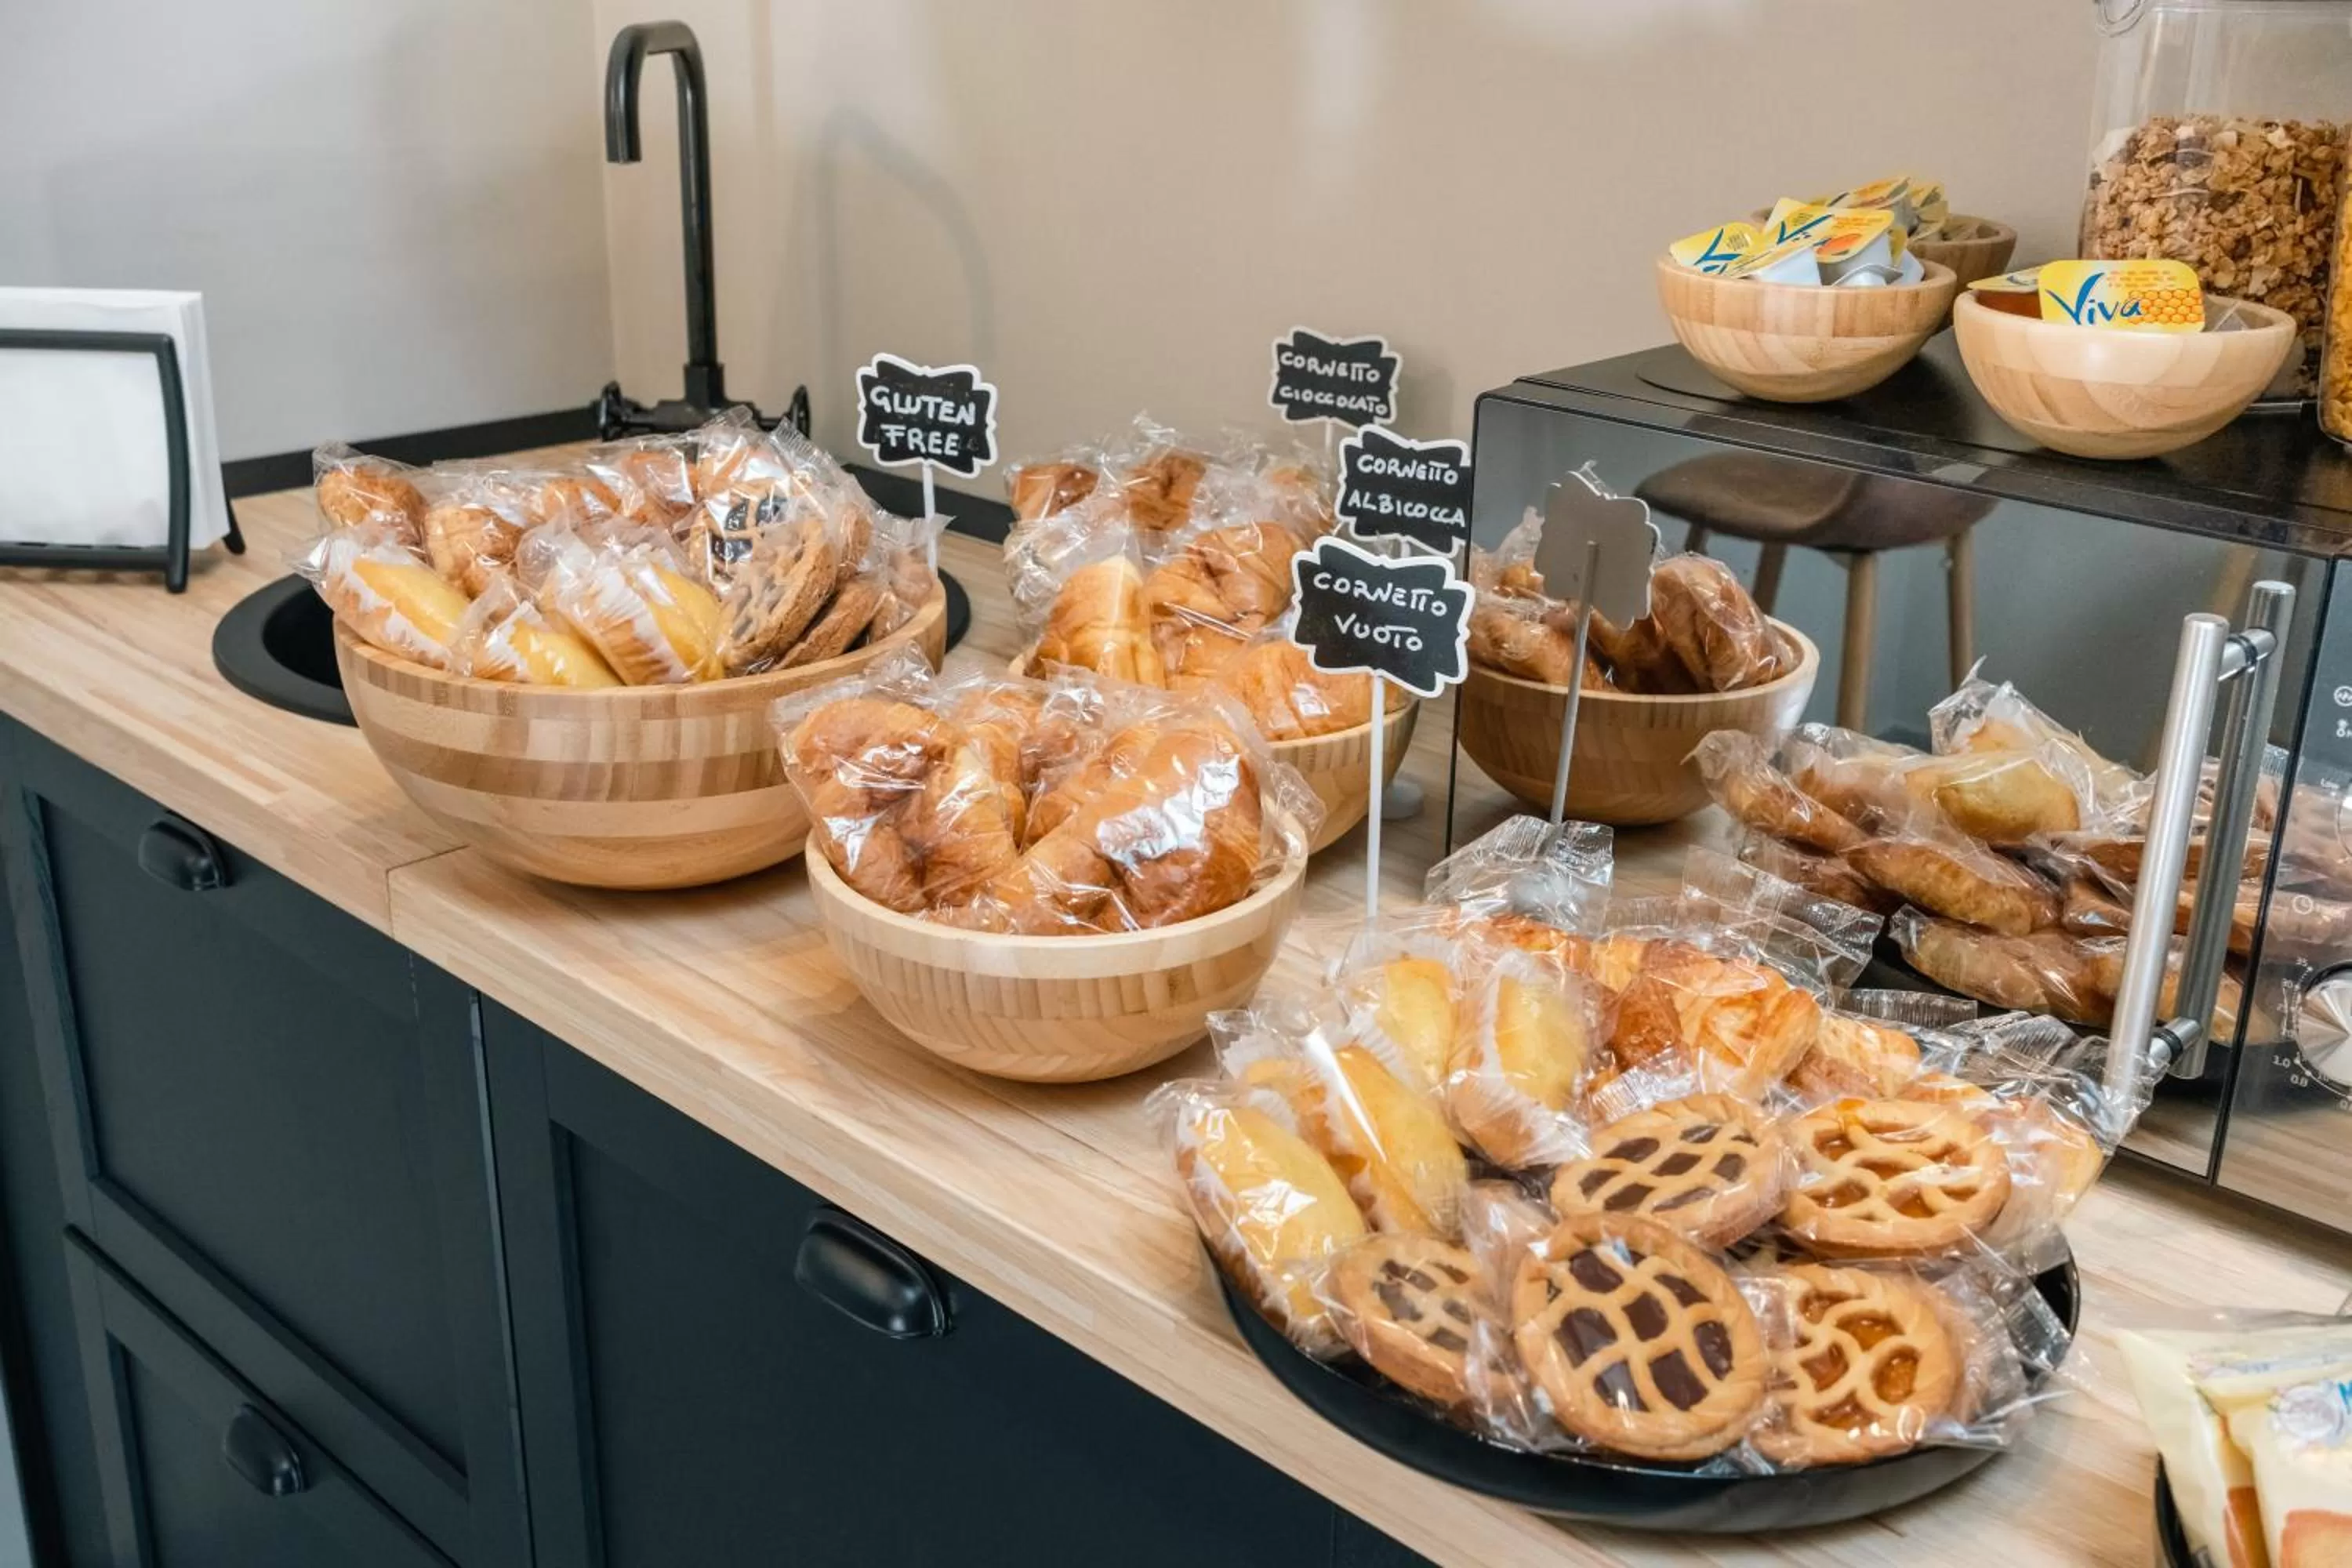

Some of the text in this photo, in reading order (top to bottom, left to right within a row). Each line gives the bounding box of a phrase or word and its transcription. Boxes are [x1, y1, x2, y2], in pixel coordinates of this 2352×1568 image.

[2045, 272, 2143, 325] Viva
[1279, 352, 1381, 382] CORNETTO
[870, 385, 976, 426] GLUTEN
[1279, 386, 1388, 416] CIOCCOLATO
[880, 423, 960, 456] FREE
[1357, 454, 1458, 485] CORNETTO
[1348, 488, 1466, 527] ALBICOCCA
[1313, 572, 1447, 617] CORNETTO
[1334, 612, 1423, 652] VUOTO
